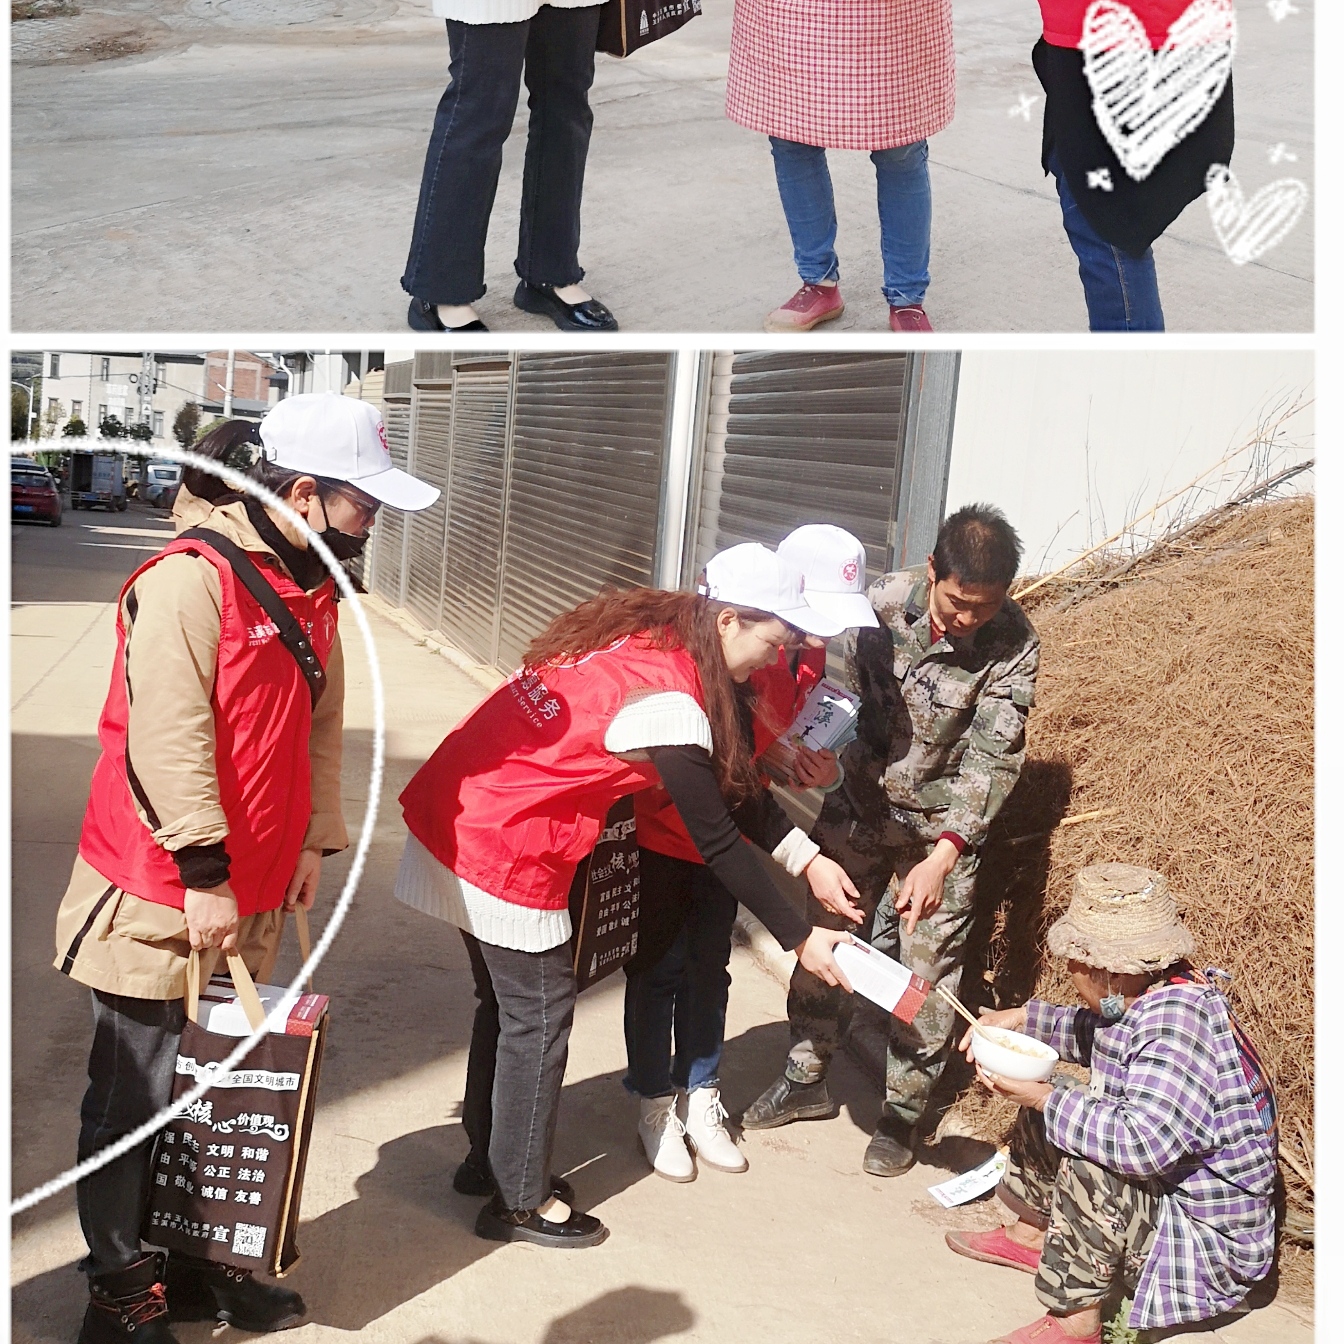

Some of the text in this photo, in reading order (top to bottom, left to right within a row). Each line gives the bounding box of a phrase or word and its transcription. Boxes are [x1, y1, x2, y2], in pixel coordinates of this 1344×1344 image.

[517, 696, 543, 728] Service
[232, 1073, 296, 1087] 全国文明城市
[206, 1143, 234, 1158] 文明
[241, 1146, 269, 1162] 和谐
[203, 1164, 231, 1179] 公正
[237, 1168, 266, 1183] 法治
[200, 1185, 228, 1201] 诚信
[234, 1190, 262, 1206] 友善
[211, 1225, 230, 1243] 宣
